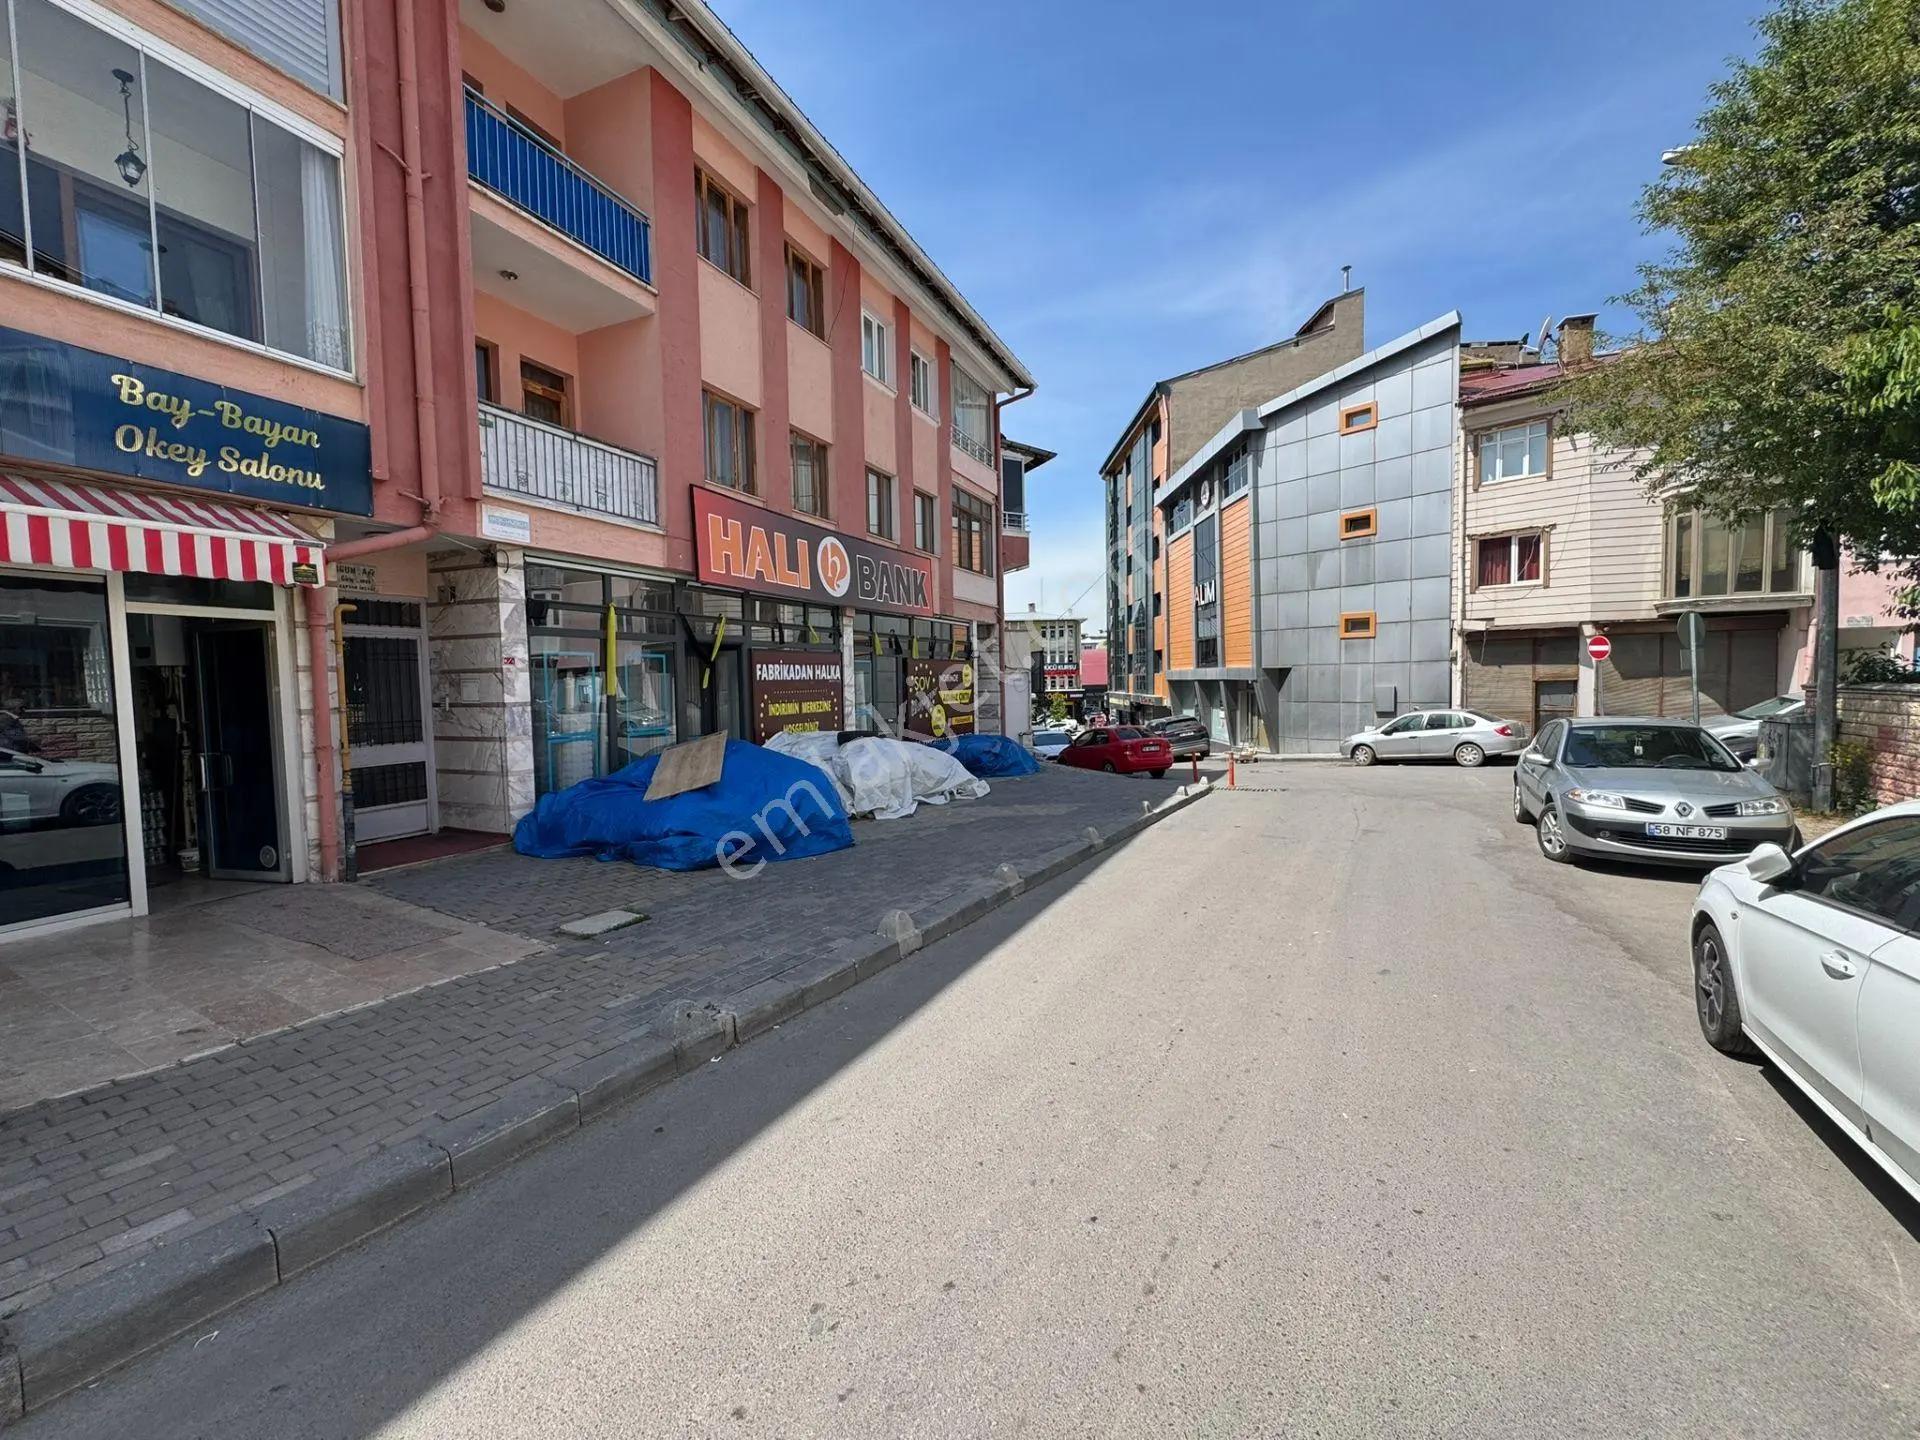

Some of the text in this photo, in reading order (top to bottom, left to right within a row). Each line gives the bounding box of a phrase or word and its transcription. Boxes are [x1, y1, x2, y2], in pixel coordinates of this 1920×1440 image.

[111, 374, 321, 449] Bay-Bayan
[115, 424, 325, 490] Okey Salonu
[707, 513, 811, 590] HALI
[856, 554, 932, 610] BANK
[756, 659, 841, 680] FABRİKADAN HALKA
[1656, 825, 1722, 838] 58 NF 875
